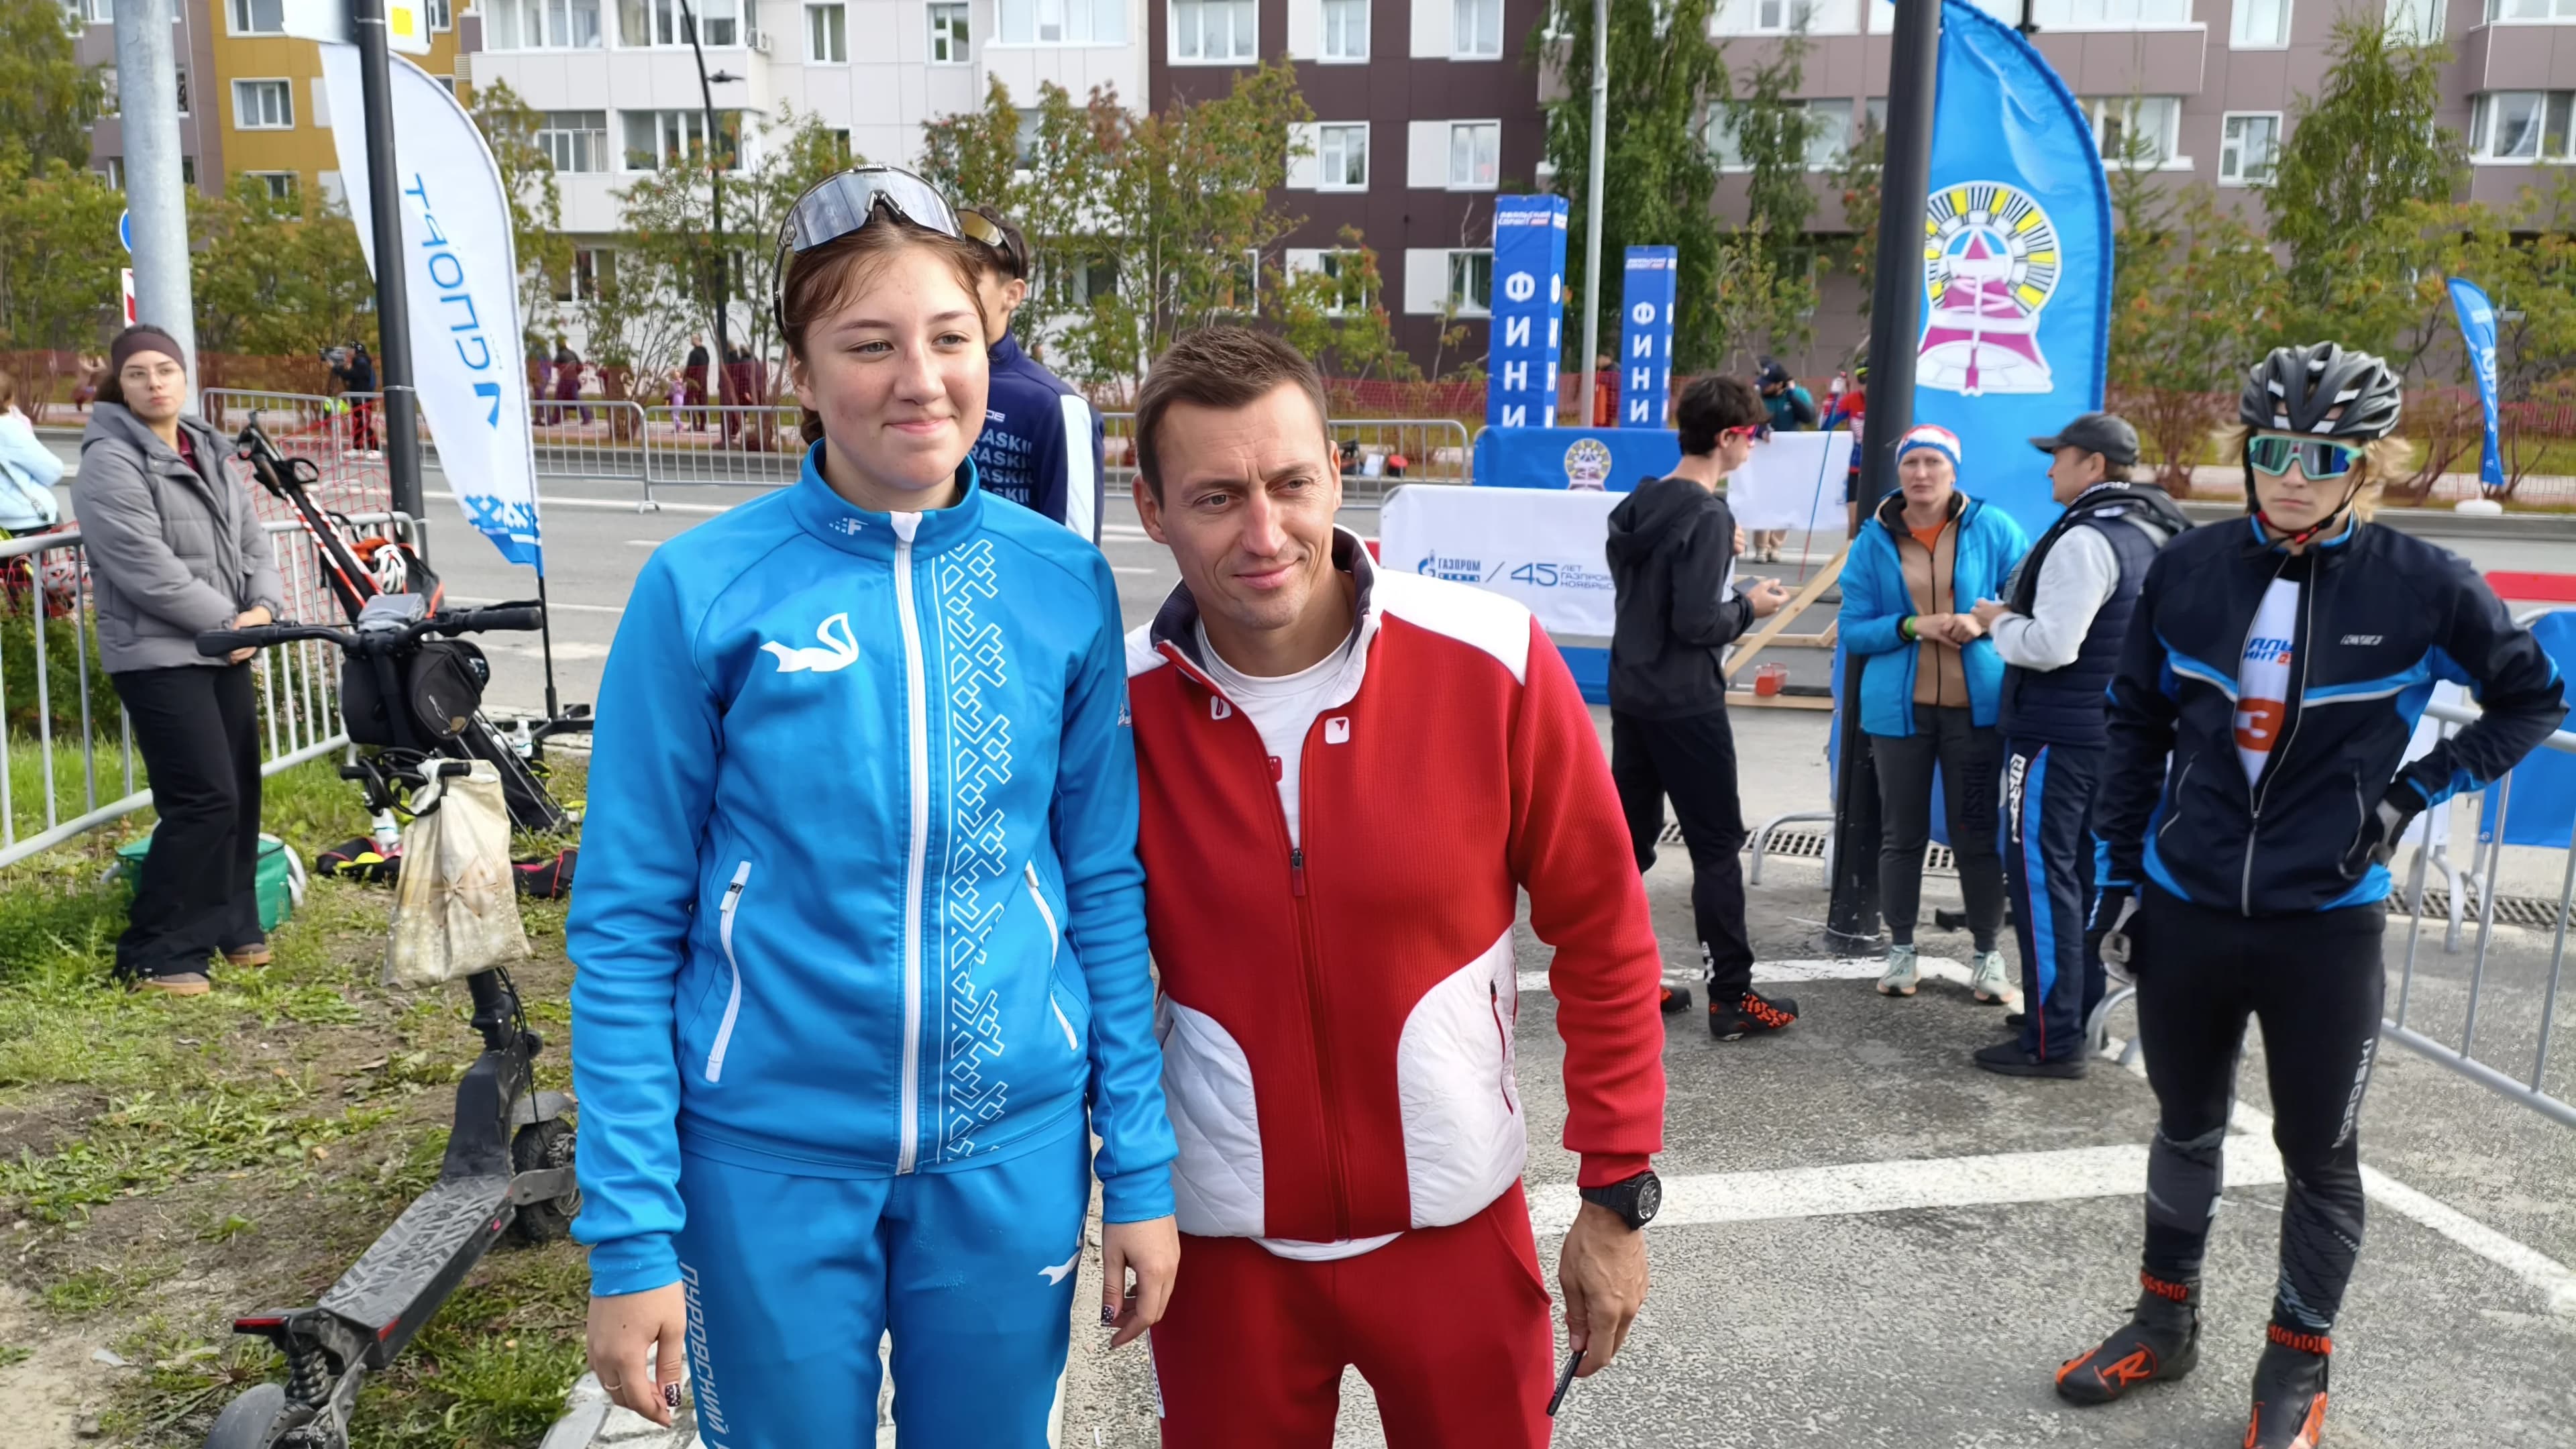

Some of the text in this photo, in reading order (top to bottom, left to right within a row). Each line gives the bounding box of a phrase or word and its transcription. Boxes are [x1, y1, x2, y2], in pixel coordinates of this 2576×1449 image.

[1438, 557, 1481, 571] ГАЗПРОМ
[1511, 563, 1582, 586] 45 ЛЕТ
[679, 1260, 730, 1435] ПУРОВСКИЙ
